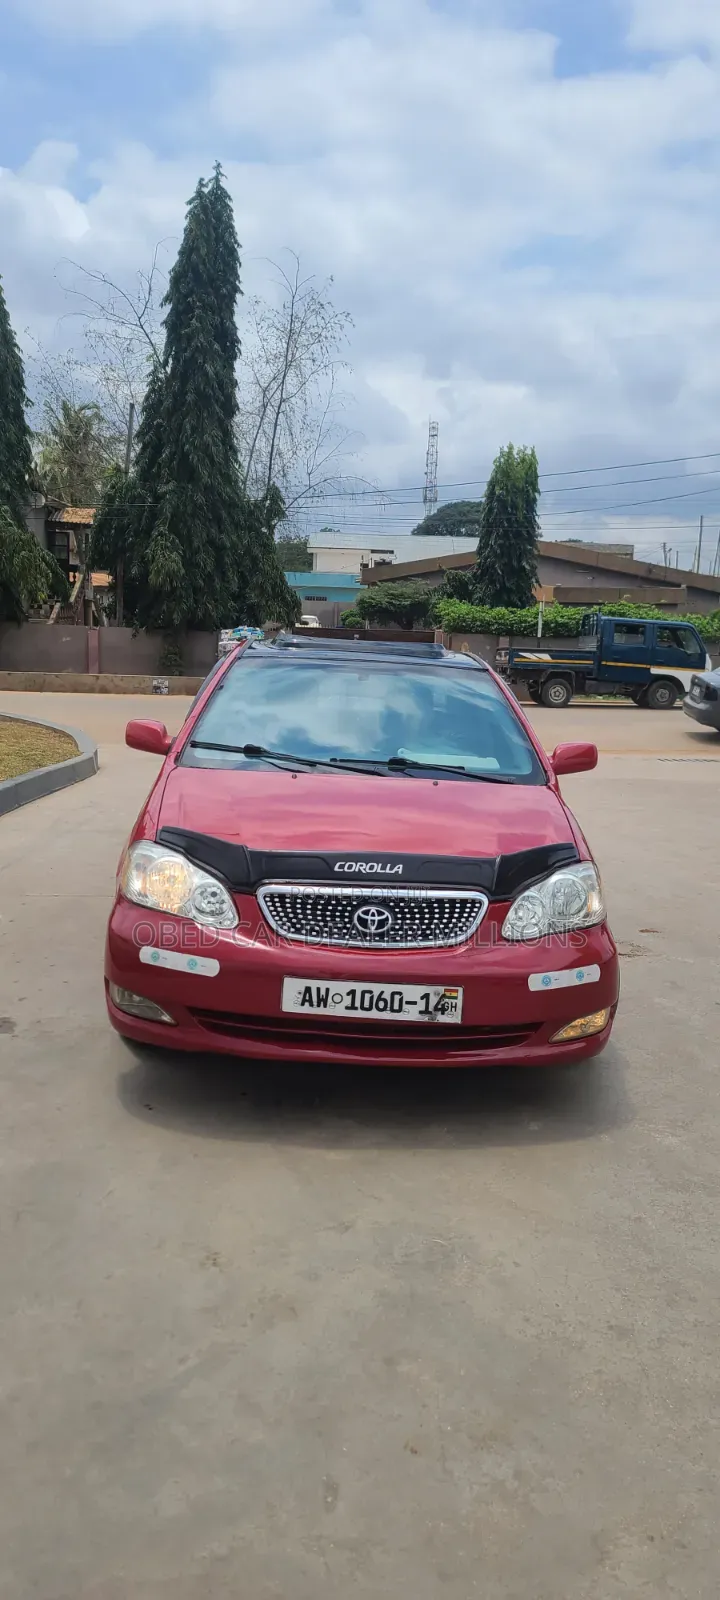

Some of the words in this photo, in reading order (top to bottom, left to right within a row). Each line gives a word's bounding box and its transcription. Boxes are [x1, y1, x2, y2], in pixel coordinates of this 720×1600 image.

[334, 861, 403, 874] COROLLA
[301, 986, 330, 1008] AW
[344, 989, 446, 1015] 1060-14
